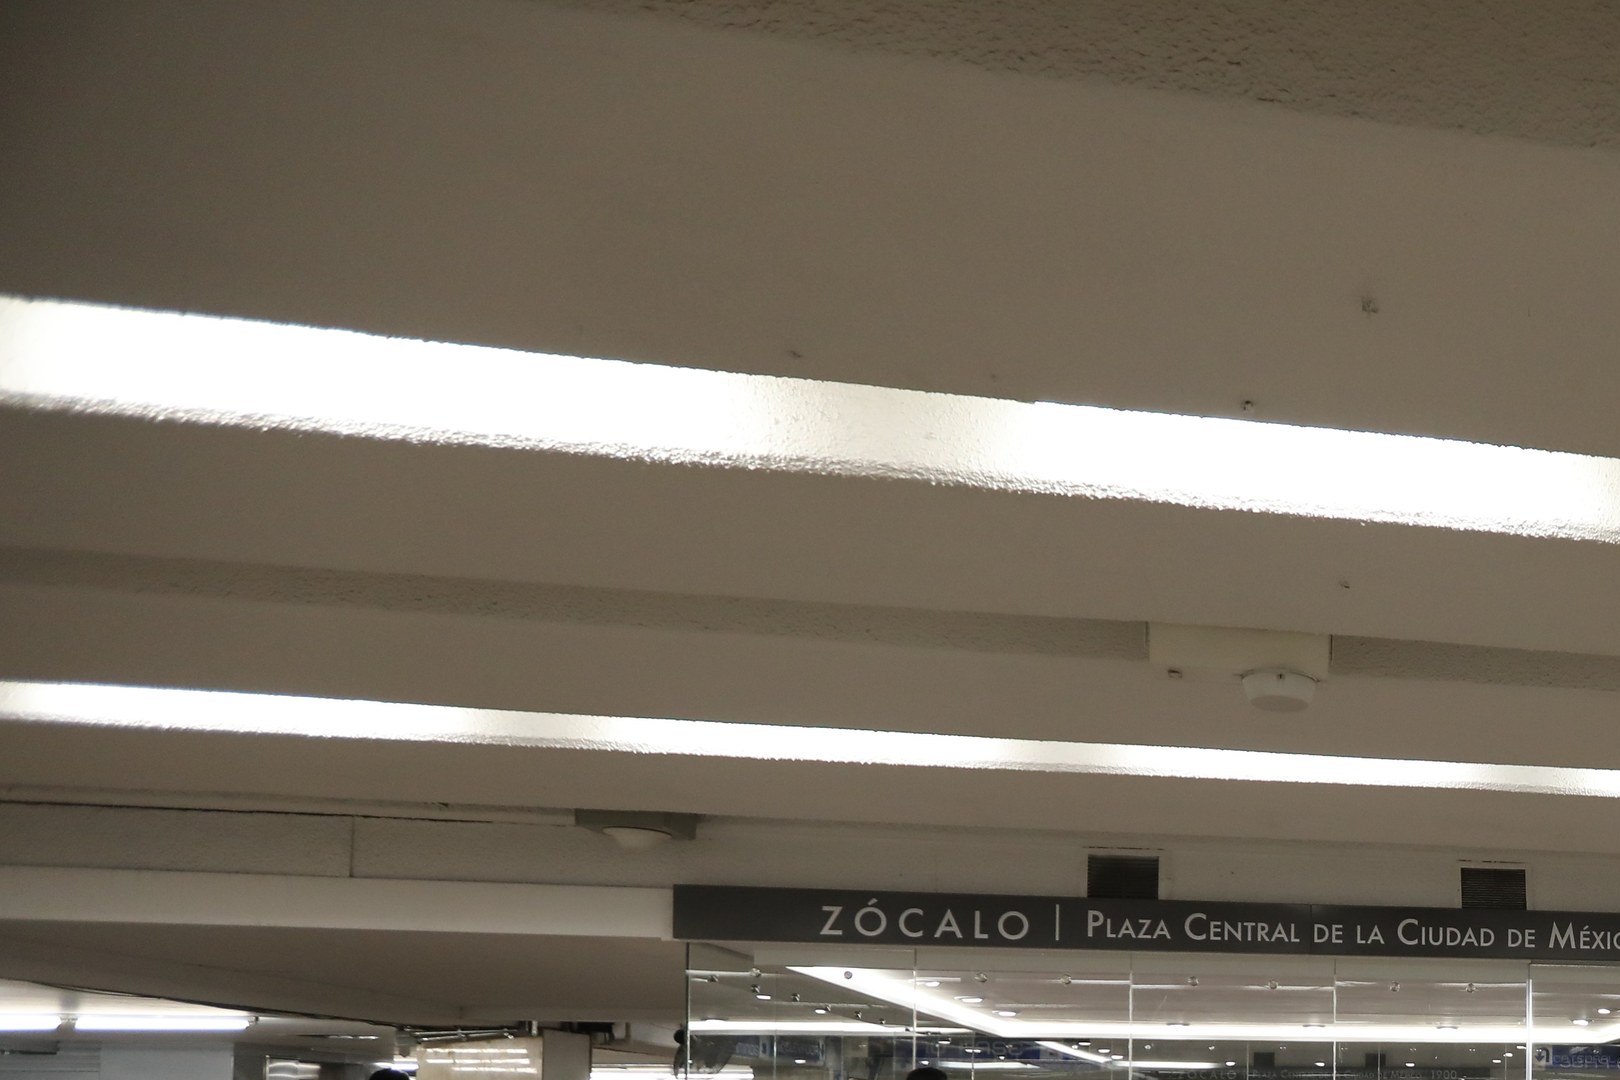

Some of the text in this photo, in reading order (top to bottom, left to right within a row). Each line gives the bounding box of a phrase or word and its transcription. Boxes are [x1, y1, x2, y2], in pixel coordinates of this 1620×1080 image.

[820, 898, 1029, 940] ZÓCALO
[1087, 909, 1172, 938] PLAZA
[1184, 912, 1300, 942] CENTRAL
[1313, 924, 1343, 943] DE
[1356, 925, 1386, 944] LA
[1396, 919, 1495, 947] CIUDAD
[1507, 928, 1536, 947] DE
